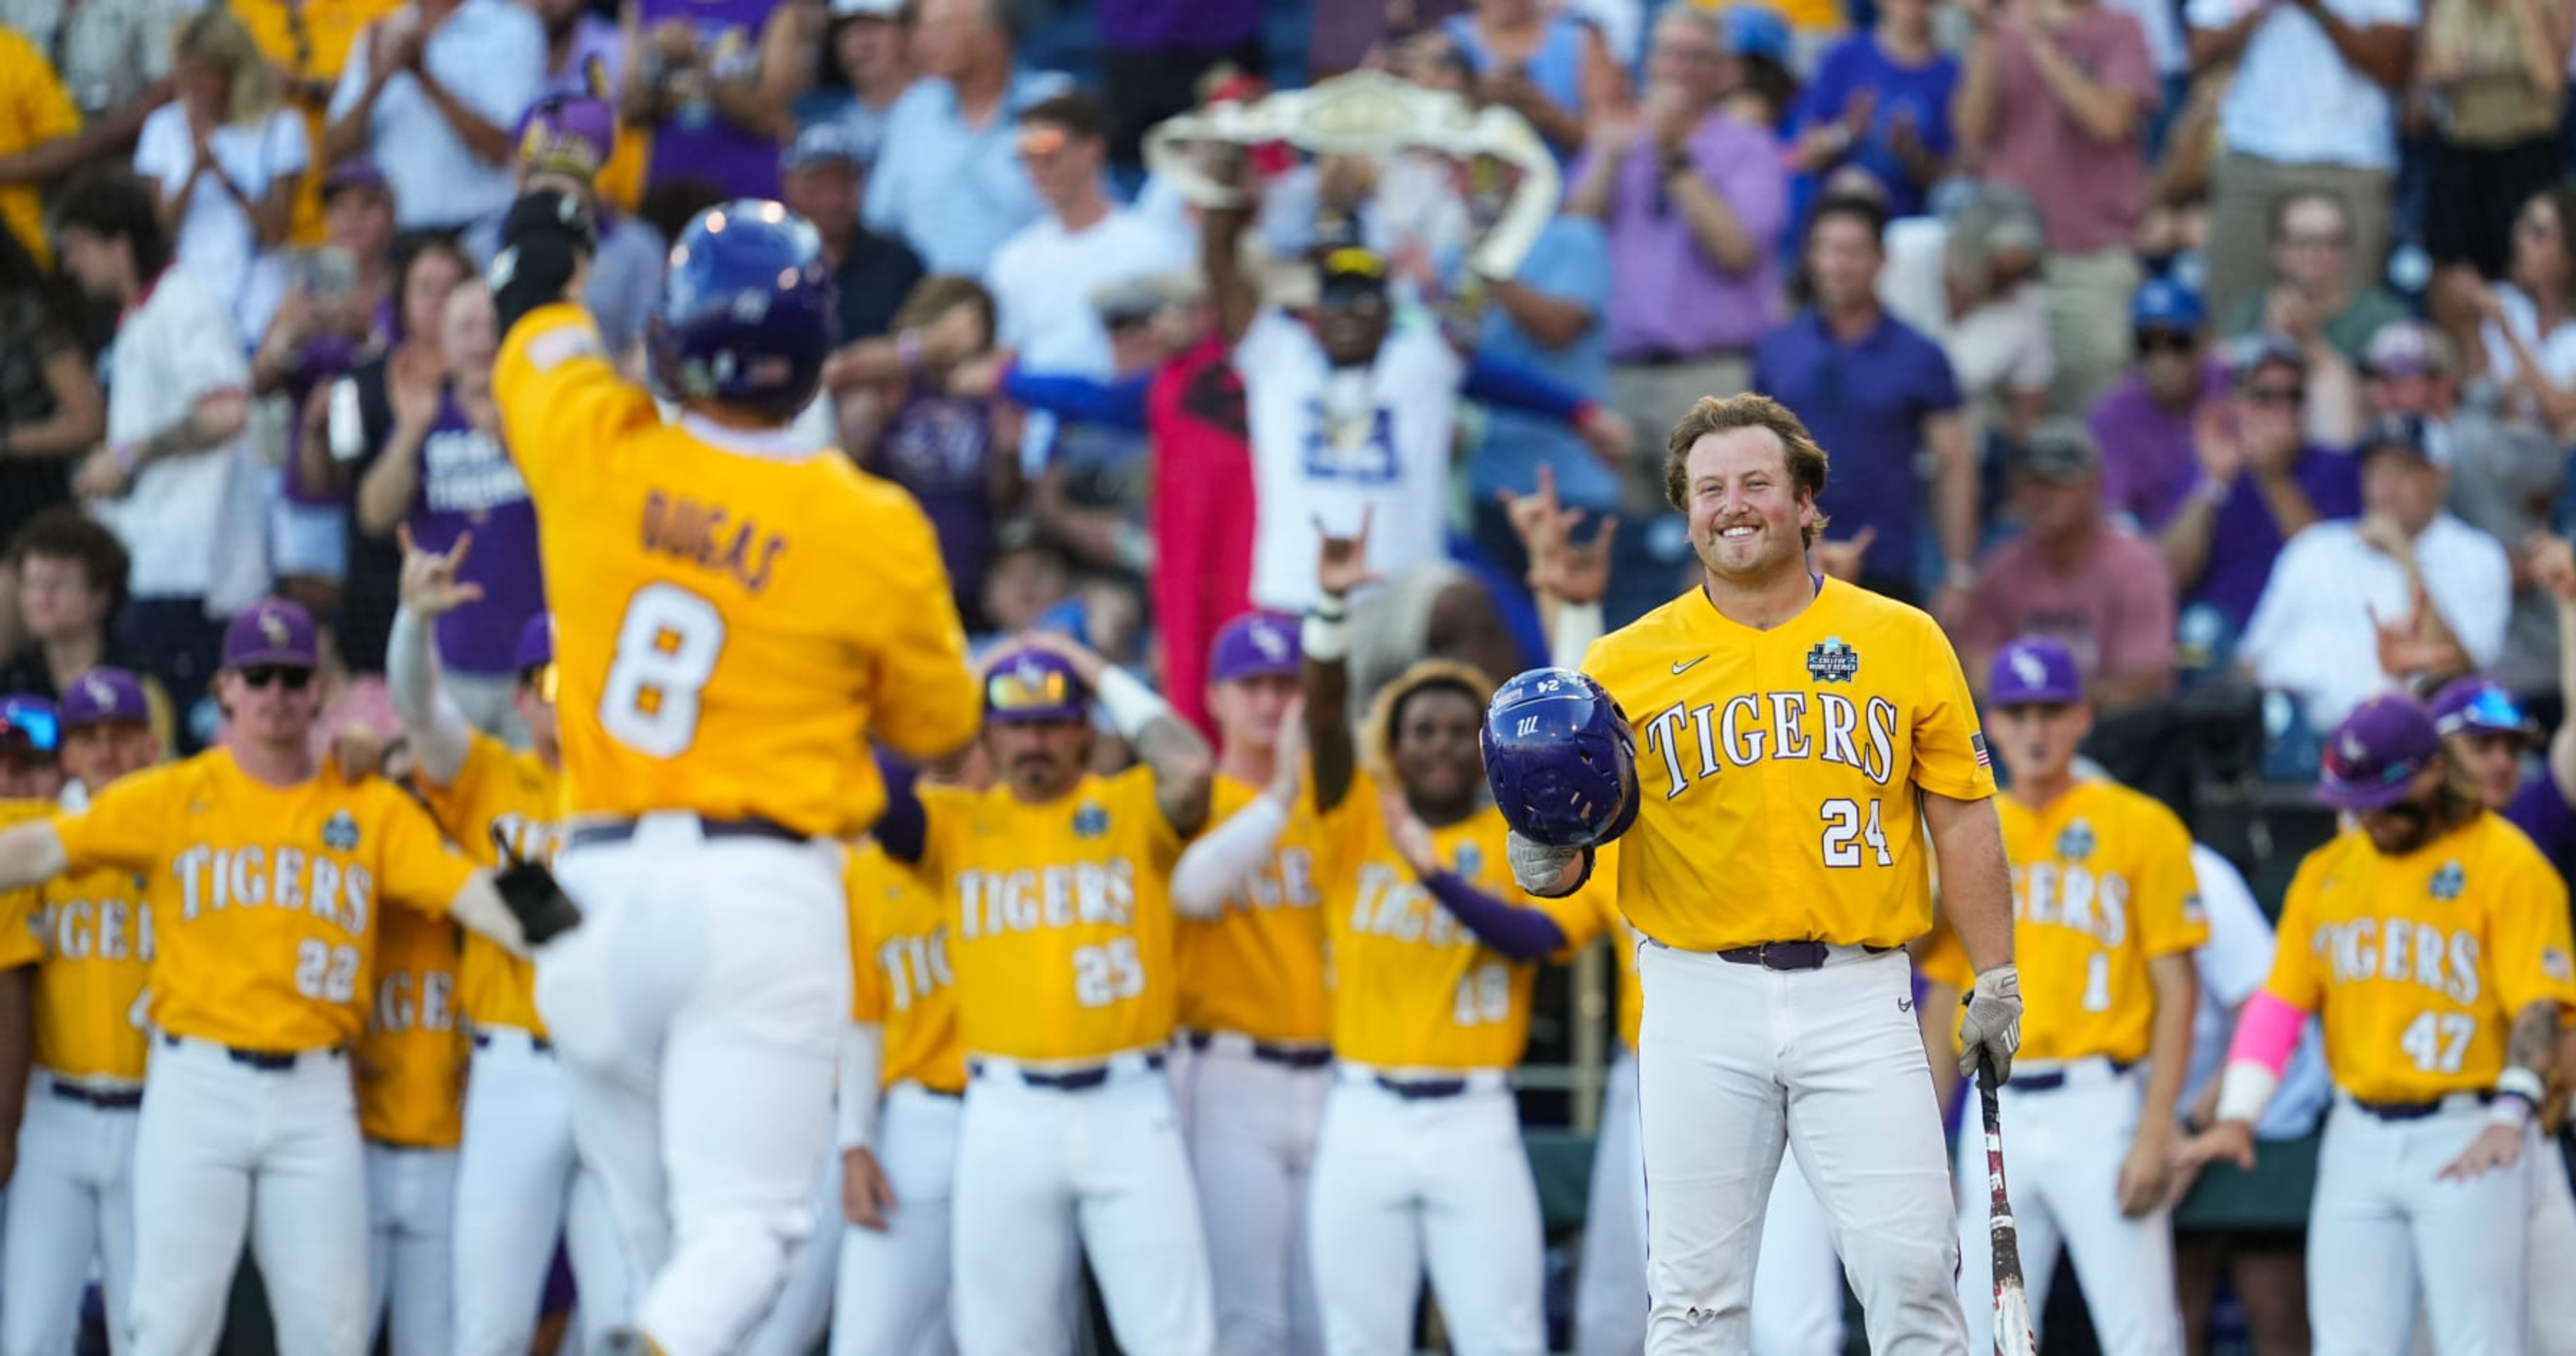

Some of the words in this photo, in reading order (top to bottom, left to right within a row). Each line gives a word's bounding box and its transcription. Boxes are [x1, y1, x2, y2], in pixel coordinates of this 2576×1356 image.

[599, 580, 727, 759] 8
[1537, 680, 1559, 694] 24
[1647, 693, 1897, 800] TIGERS
[1821, 799, 1893, 868] 24
[173, 844, 374, 936] TIGERS
[957, 857, 1135, 939] TIGERS
[294, 938, 360, 1002] 22
[1074, 937, 1144, 1007] 25
[2082, 952, 2110, 1010] 1
[2402, 1009, 2476, 1073] 47
